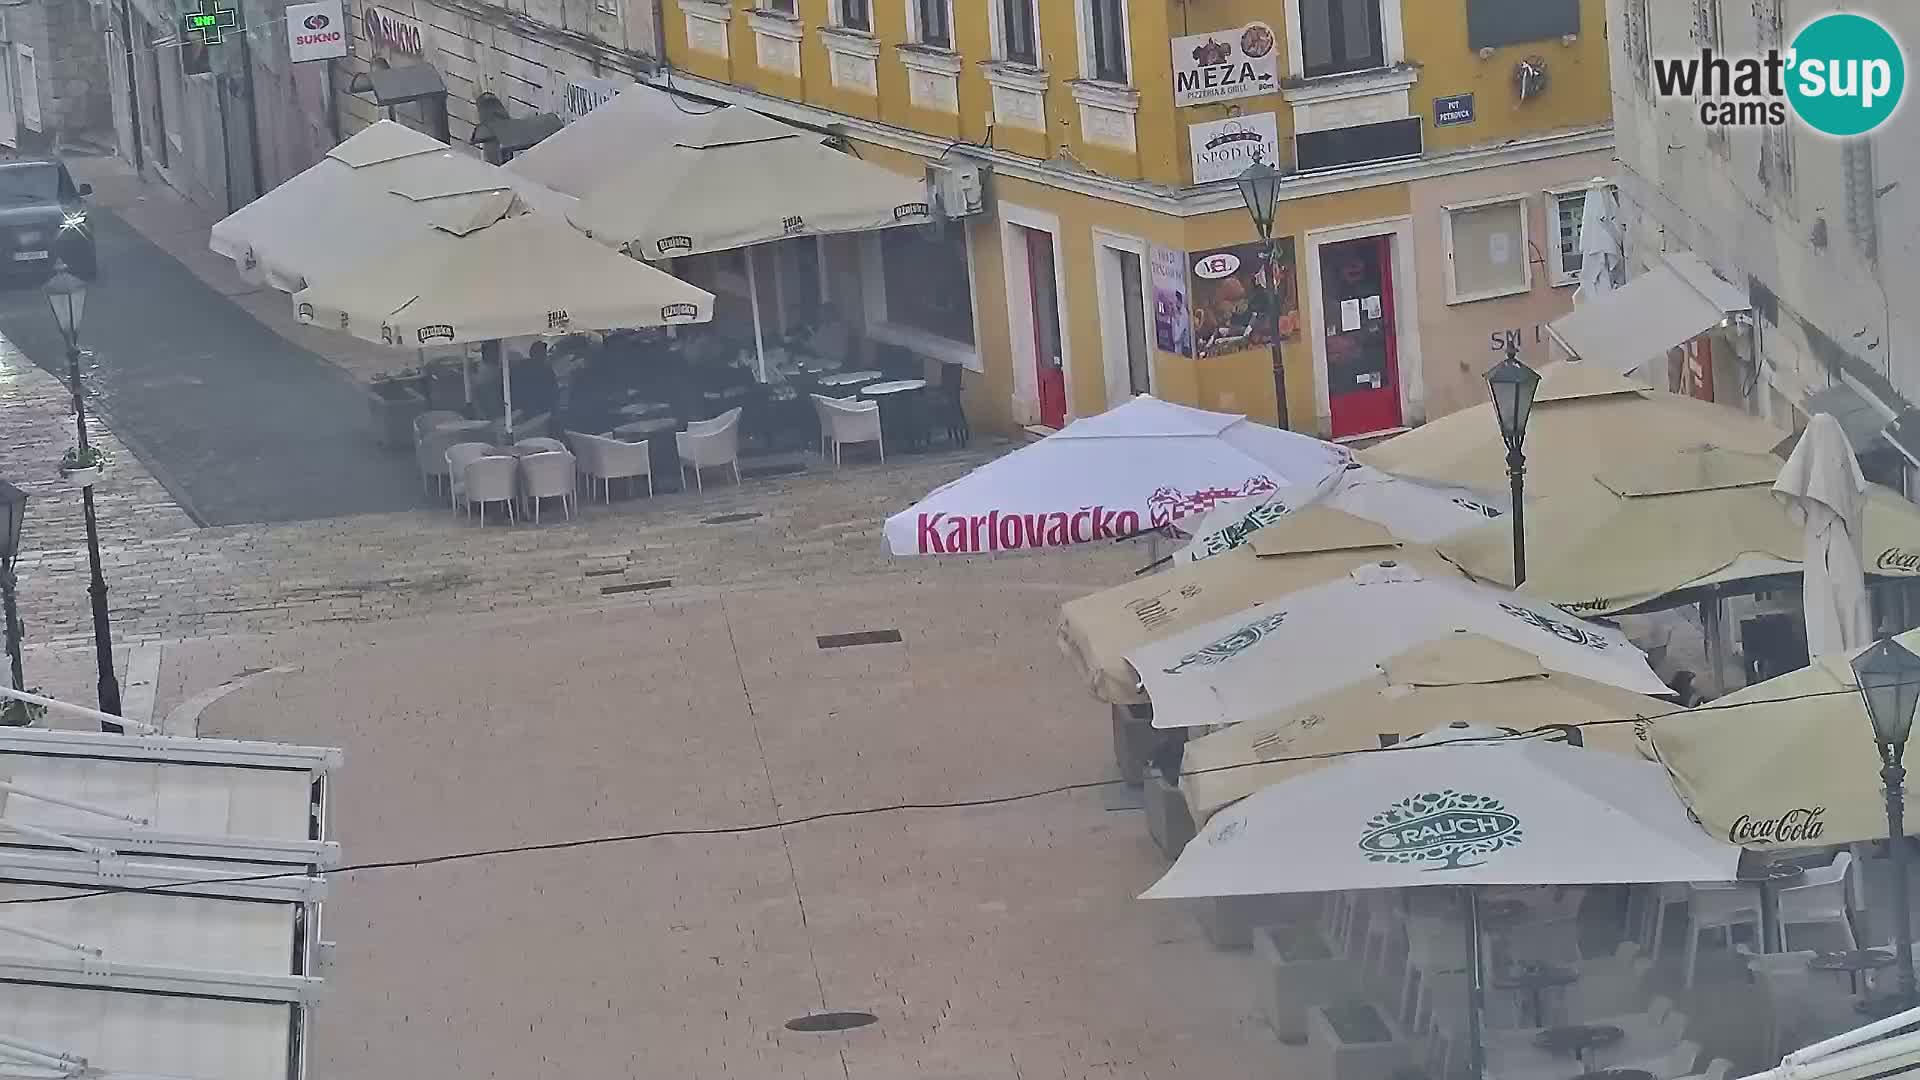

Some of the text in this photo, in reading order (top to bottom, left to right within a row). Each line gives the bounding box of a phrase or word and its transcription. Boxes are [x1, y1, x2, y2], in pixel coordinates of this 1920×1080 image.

[296, 31, 341, 46] SUKNO
[382, 15, 421, 55] SUKNO
[1177, 62, 1256, 93] MEZA
[1196, 147, 1241, 164] ISPOD
[917, 505, 1140, 554] Karlovačko
[1401, 816, 1500, 844] RAUCH
[1728, 806, 1826, 843] Coca-Cola
